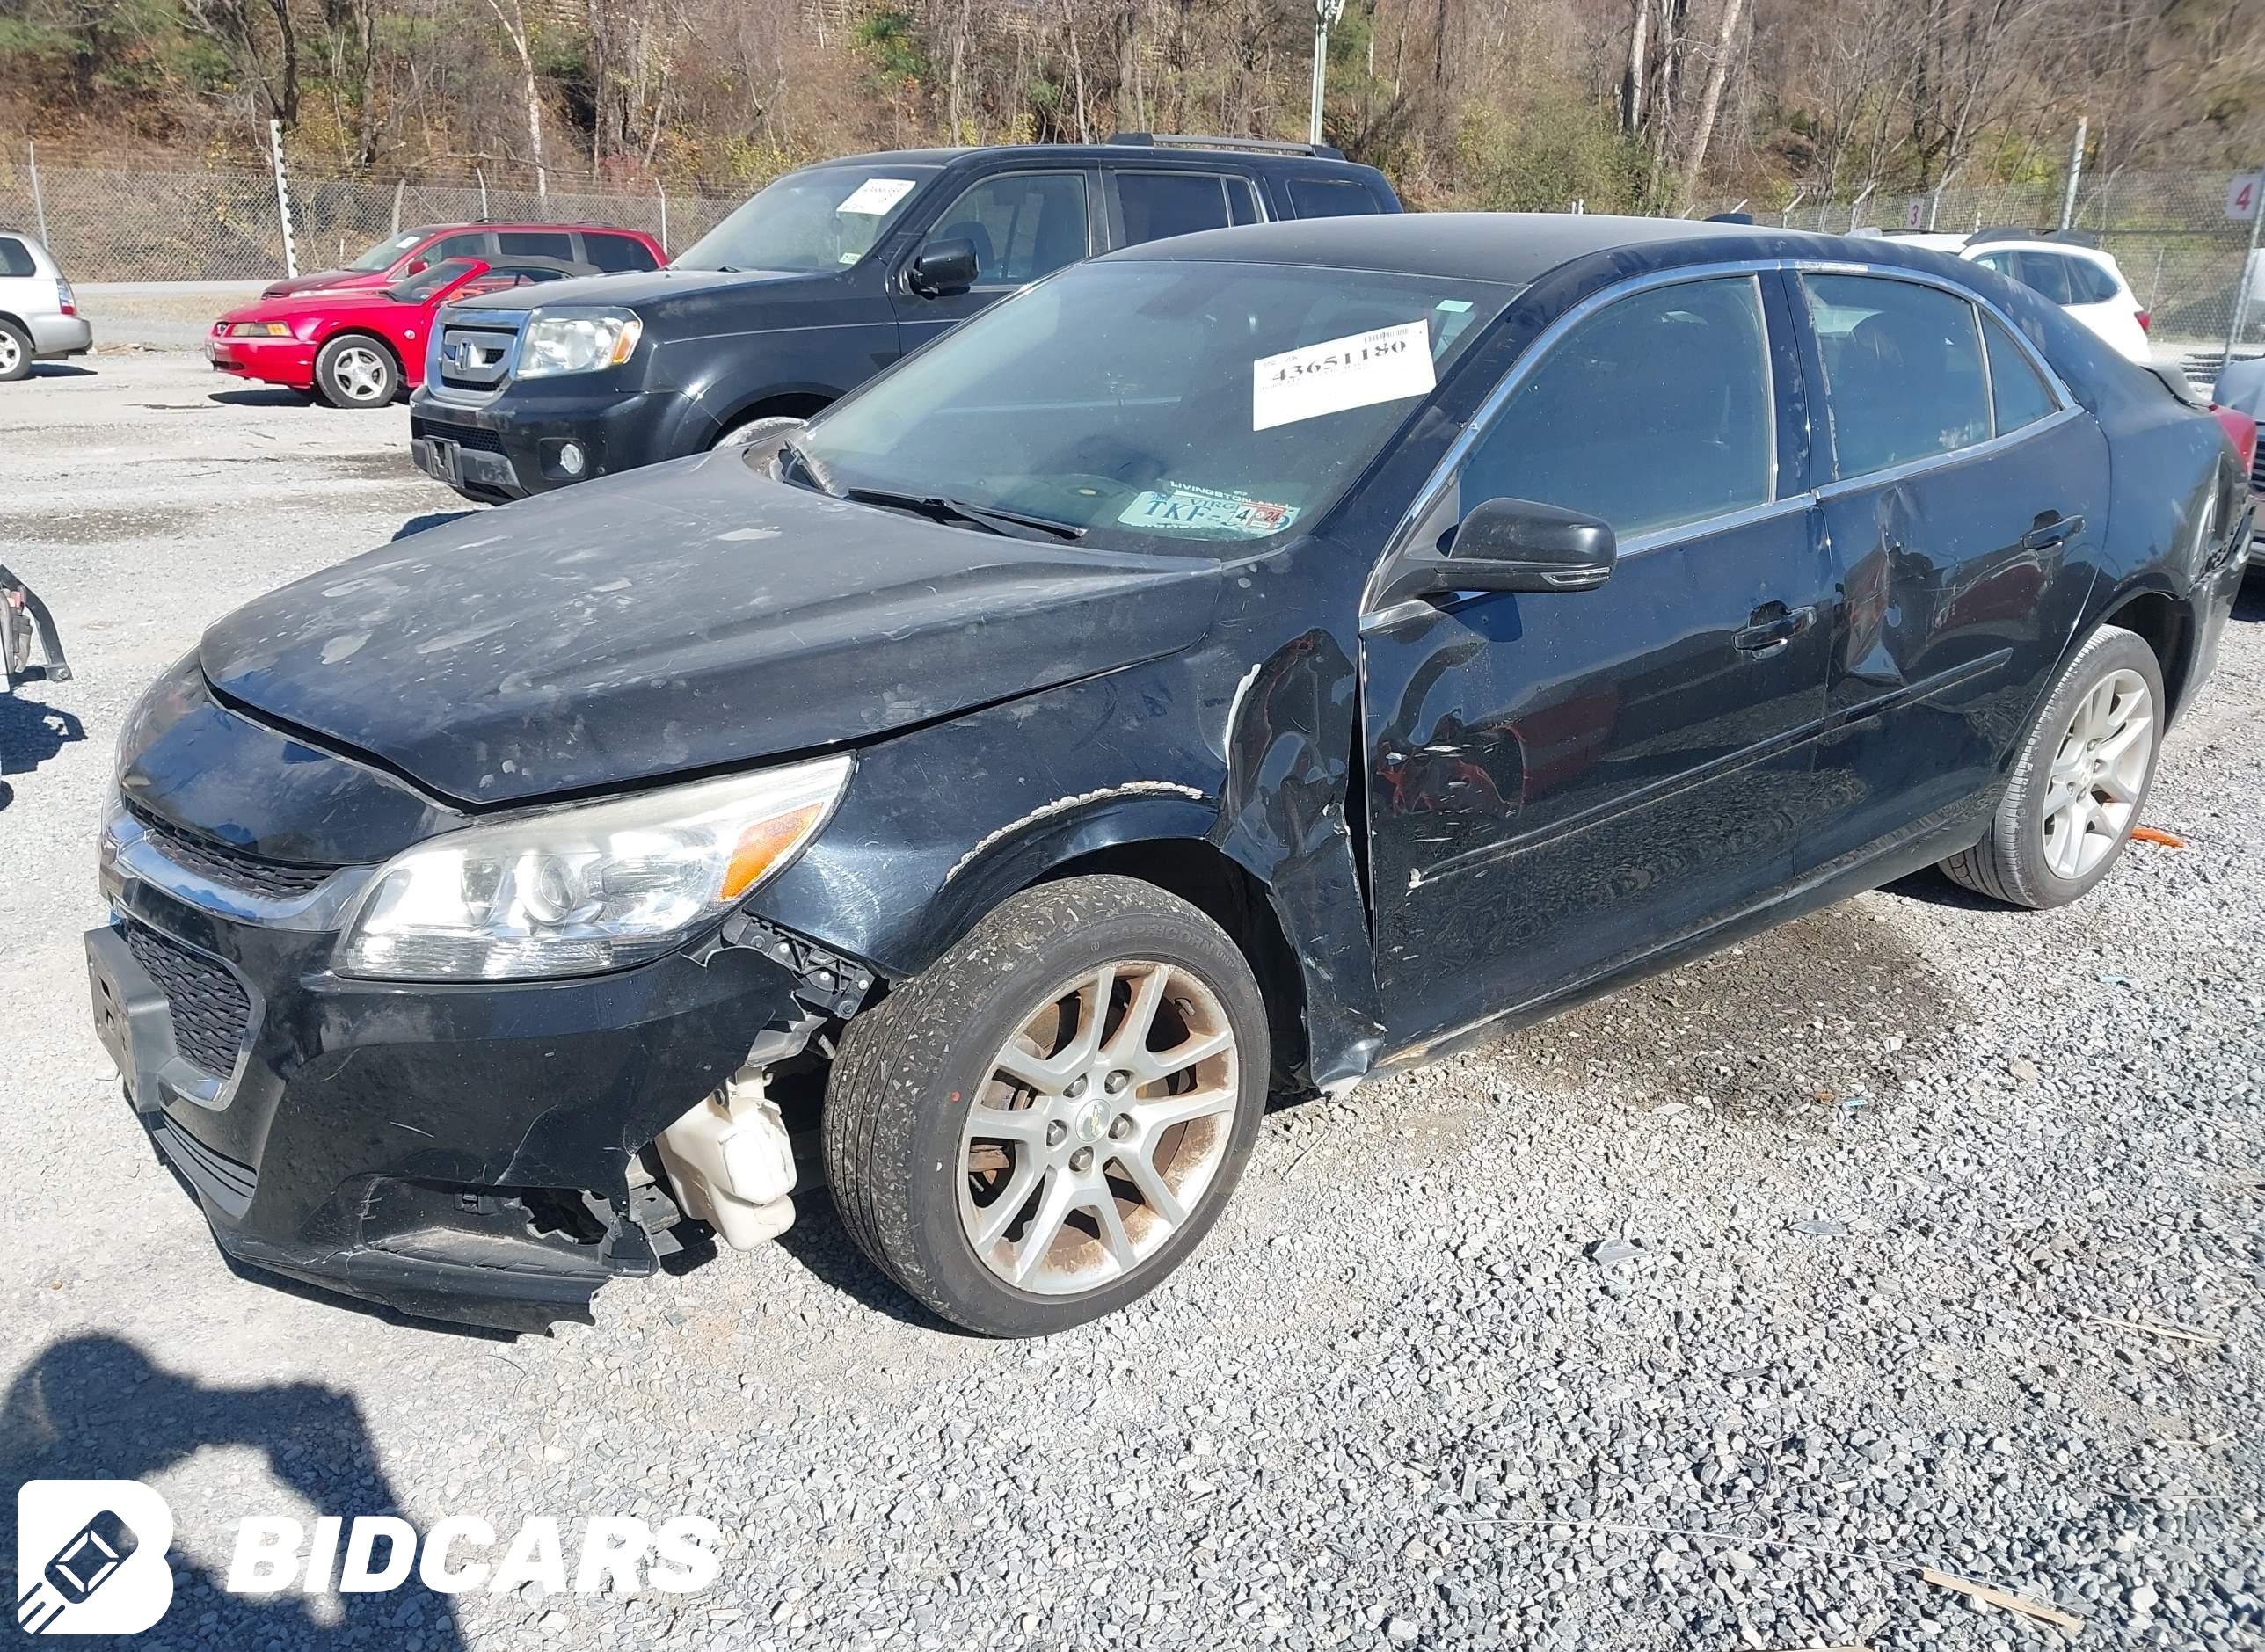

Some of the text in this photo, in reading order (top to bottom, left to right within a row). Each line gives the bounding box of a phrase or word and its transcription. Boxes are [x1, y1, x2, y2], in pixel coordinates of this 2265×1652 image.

[2235, 182, 2253, 211] 4
[1910, 205, 1919, 225] 3
[1271, 340, 1407, 382] 43651180
[1170, 481, 1251, 503] LIVINGSTON
[1191, 499, 1240, 510] VIRG
[1236, 508, 1281, 522] 4 24
